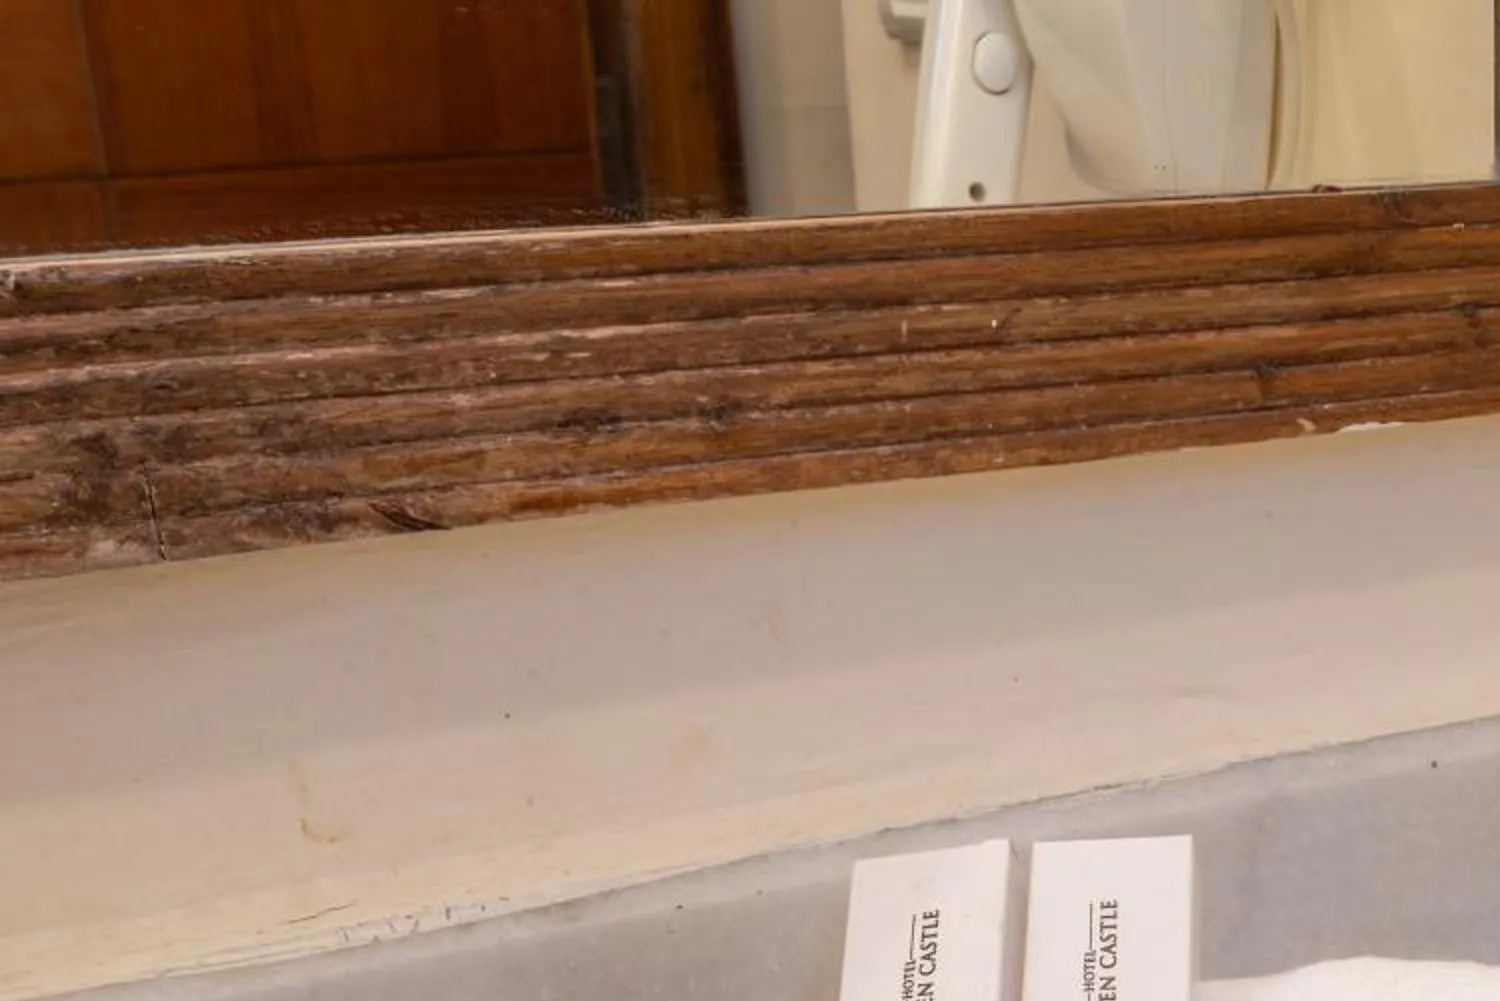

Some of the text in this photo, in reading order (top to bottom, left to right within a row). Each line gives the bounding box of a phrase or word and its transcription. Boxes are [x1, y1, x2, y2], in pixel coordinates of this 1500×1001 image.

[919, 909, 940, 977] CASTLE
[1099, 899, 1119, 970] CASTLE
[902, 959, 917, 1001] HOTEL
[1083, 949, 1097, 993] HOTEL
